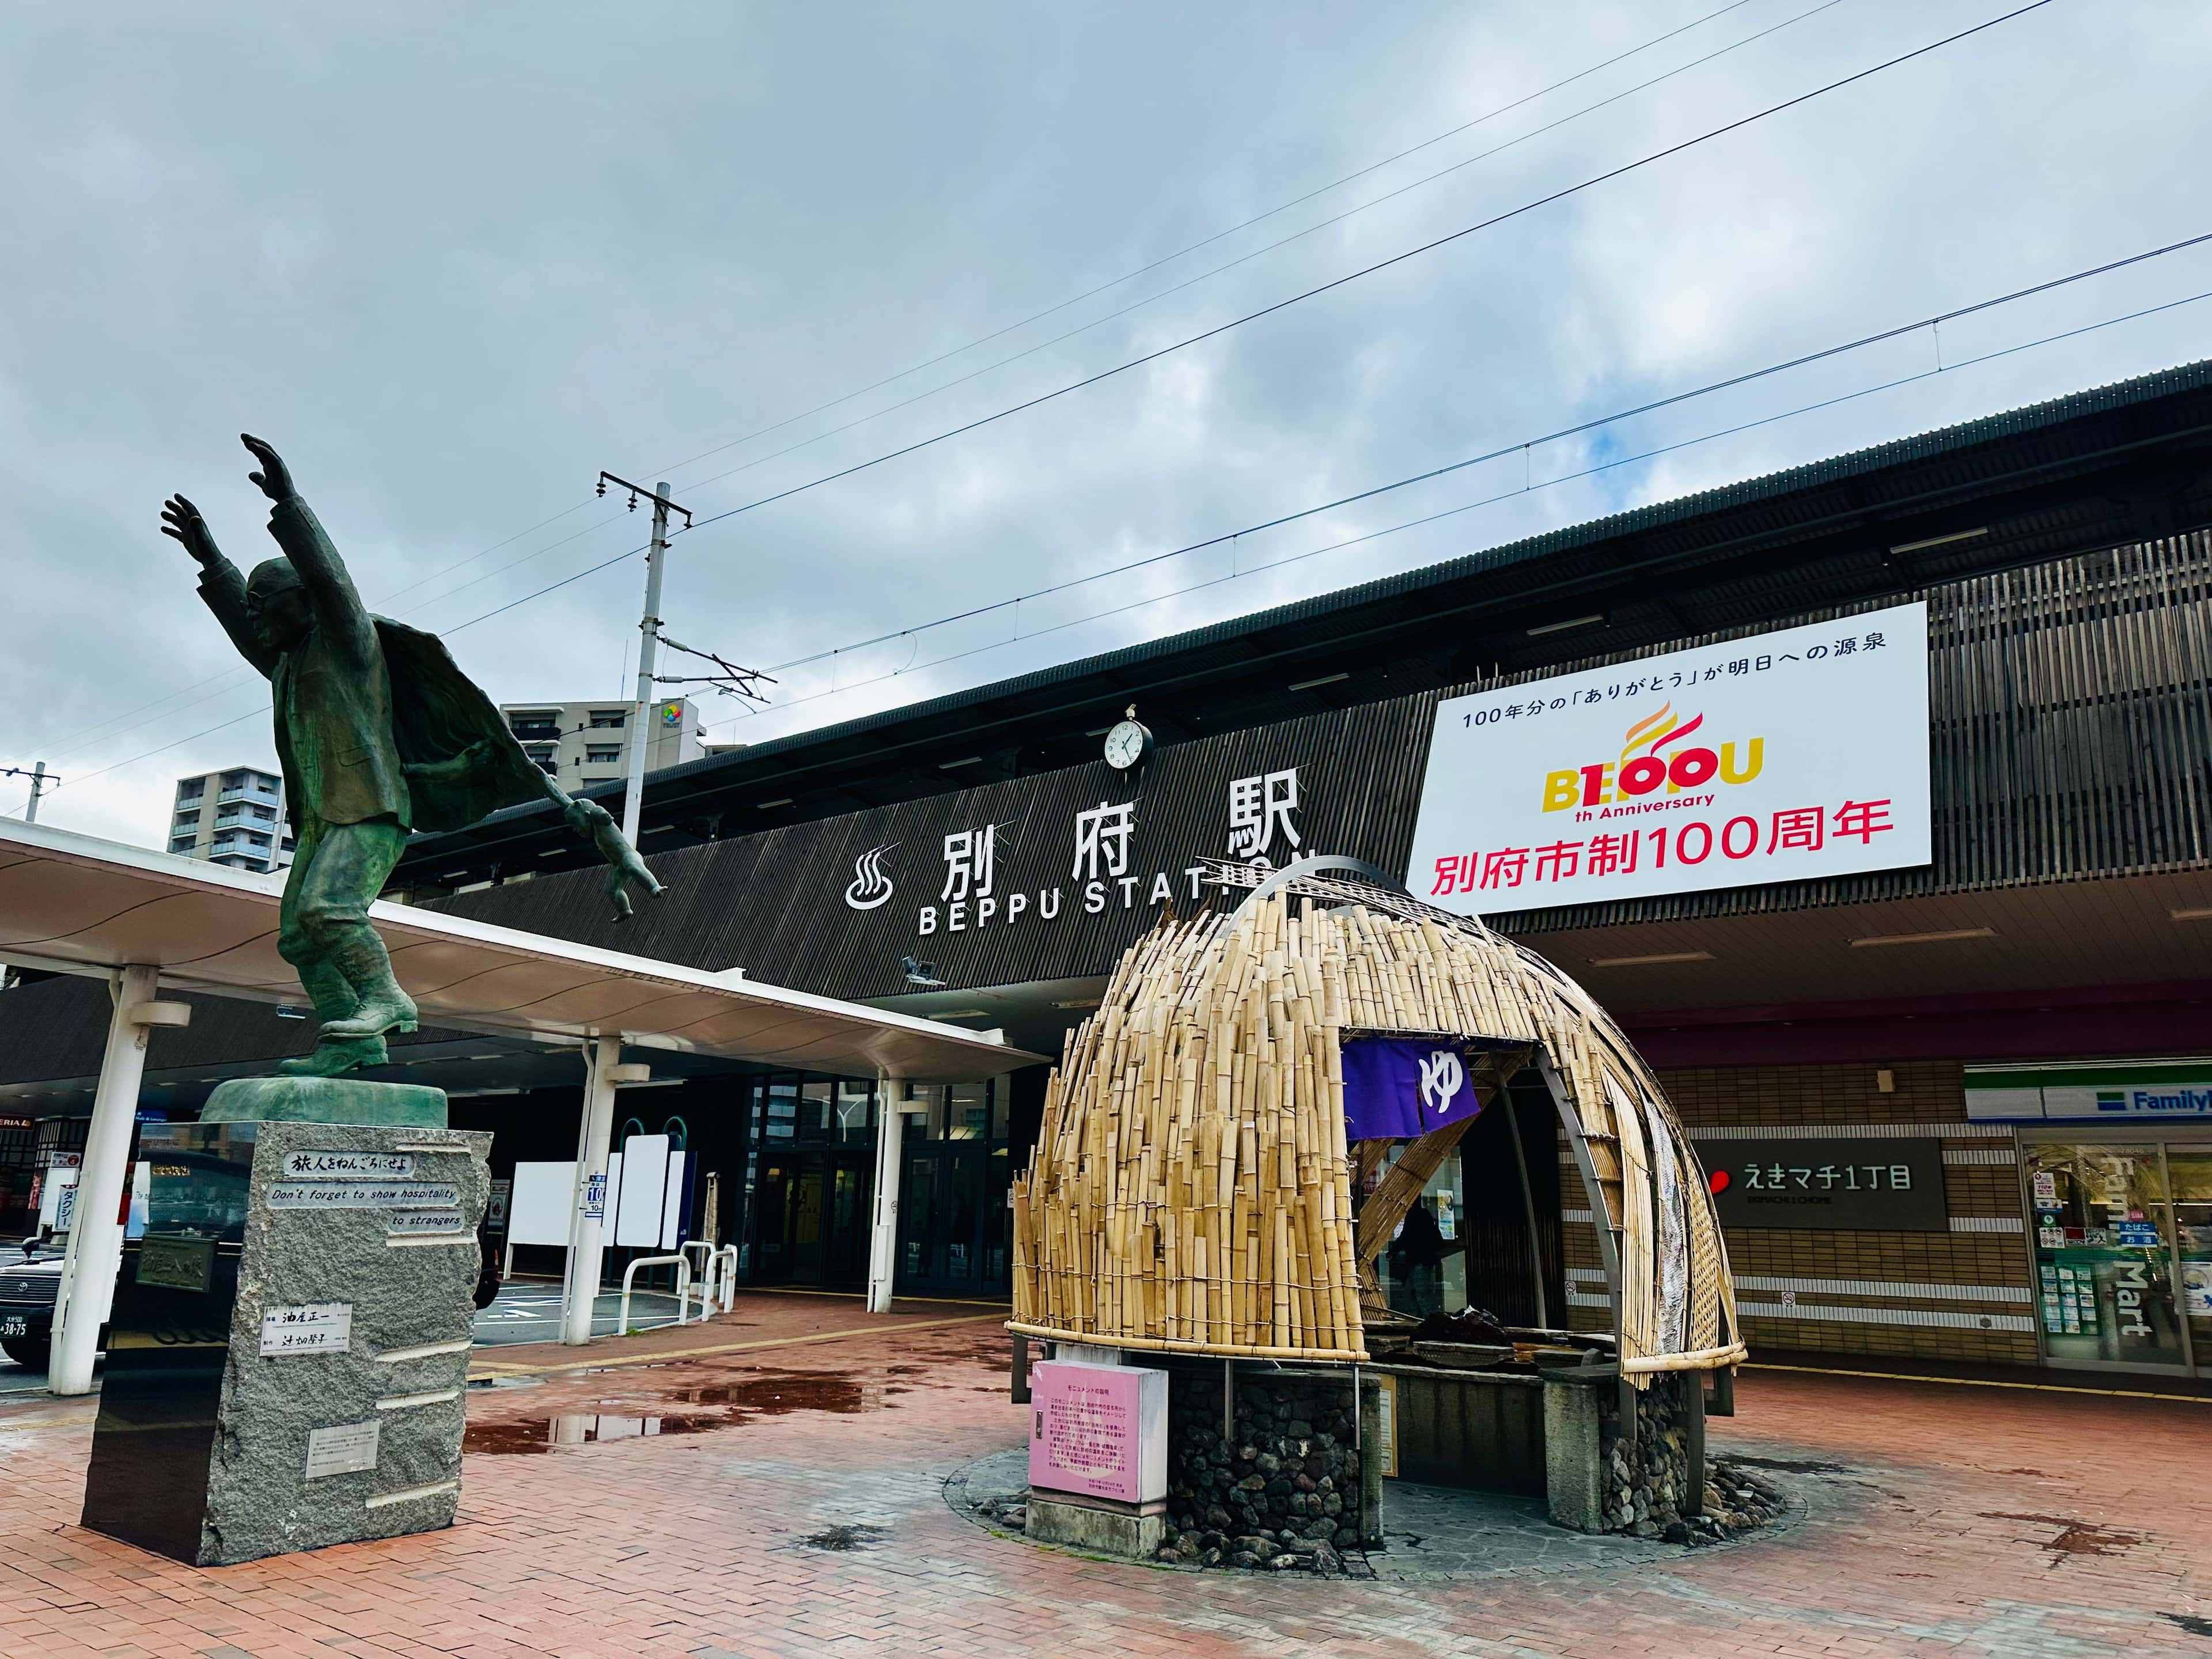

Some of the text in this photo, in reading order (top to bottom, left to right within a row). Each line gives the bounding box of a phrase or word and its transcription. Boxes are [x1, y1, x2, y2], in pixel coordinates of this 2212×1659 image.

[1463, 631, 1887, 728] 100年分の「ありがとう」が明日への源泉
[1599, 794, 1715, 819] Anniversary
[1430, 799, 1894, 896] 別府市制100周年
[919, 888, 1061, 935] BEPPU
[1419, 1050, 1463, 1114] ゆ
[2134, 1090, 2212, 1112] Family
[291, 1154, 406, 1171] 旅人をねんごろにせよ
[1744, 1163, 1910, 1190] えきマチ1丁目
[62, 1191, 73, 1226] タクシー
[272, 1189, 456, 1200] Don't forget to show hospitality
[392, 1216, 460, 1226] to strangers
[2113, 1261, 2153, 1336] Mart
